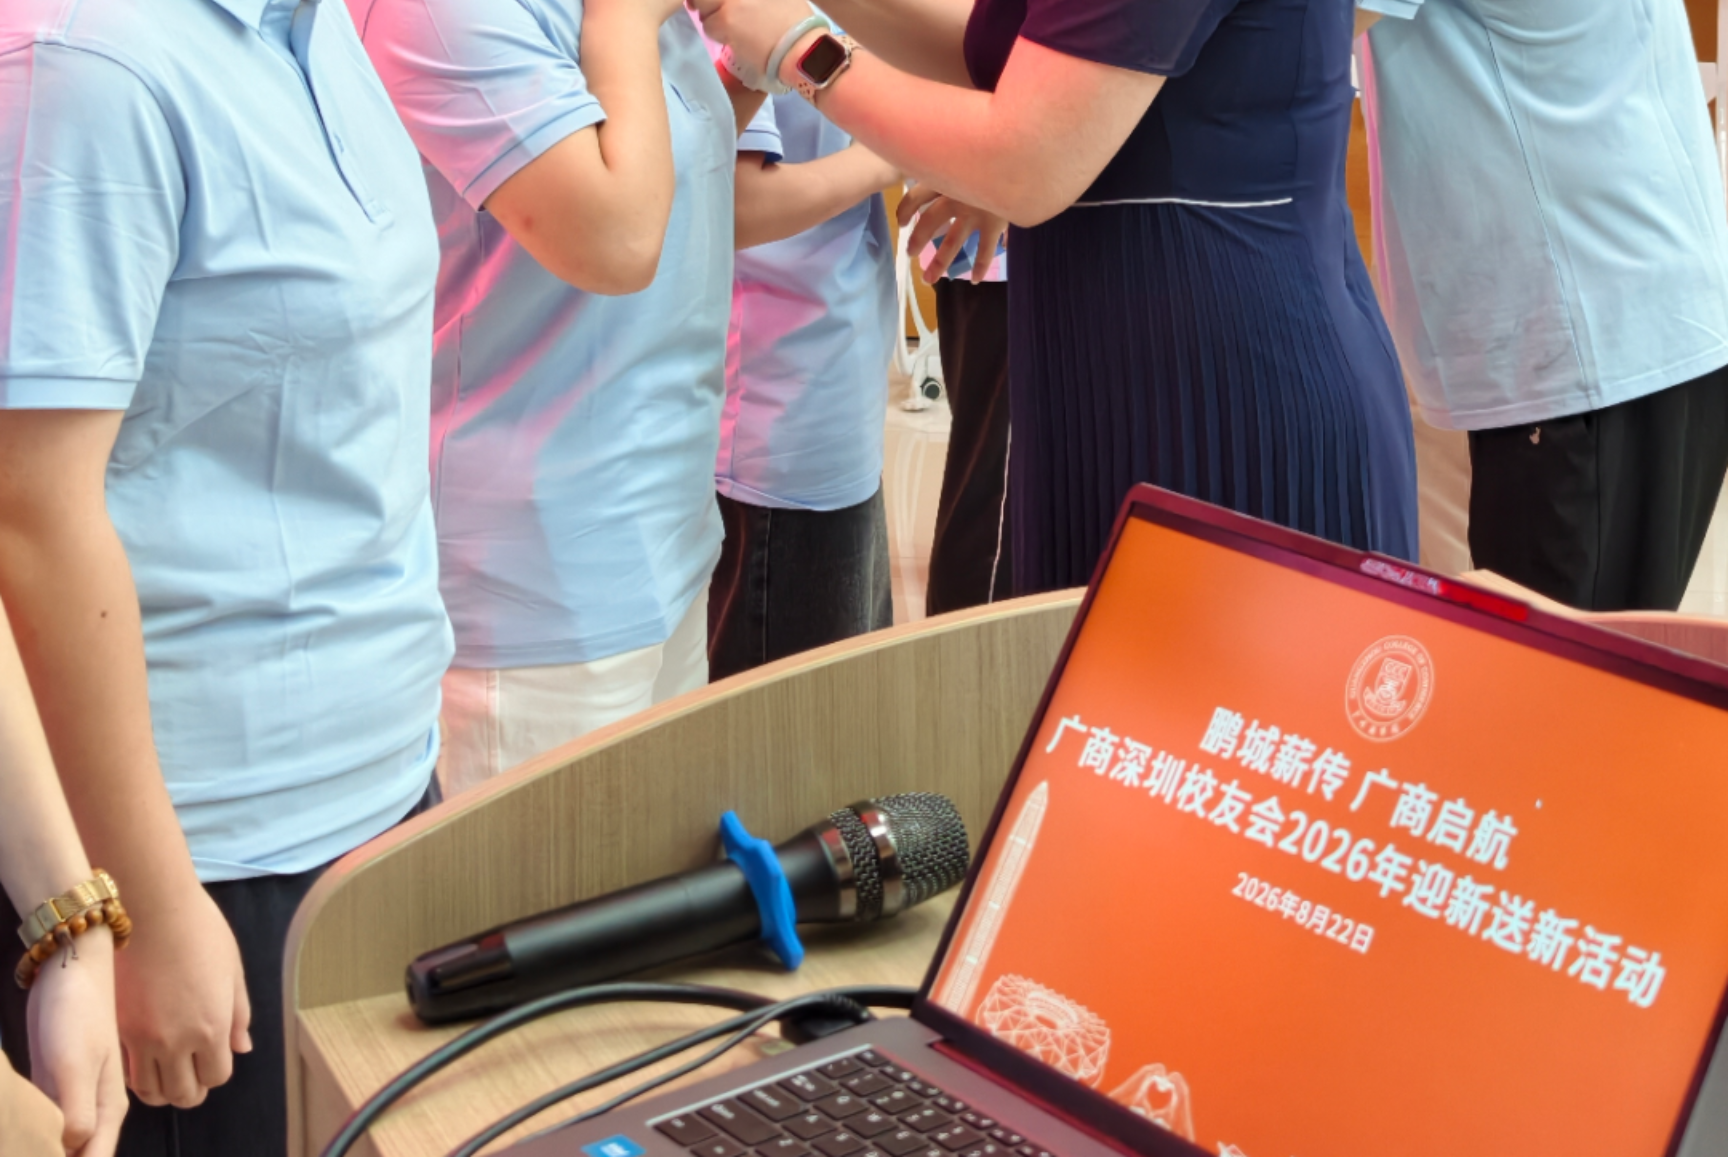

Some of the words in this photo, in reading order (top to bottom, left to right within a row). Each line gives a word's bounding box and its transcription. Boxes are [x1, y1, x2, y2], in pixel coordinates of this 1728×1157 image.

[1045, 714, 1666, 1009] 广商深圳校友会2026年迎新送新活动
[1199, 706, 1351, 801] 鹏城薪传
[1349, 768, 1518, 871] 广商启航
[1231, 871, 1375, 955] 2026年8月22日
